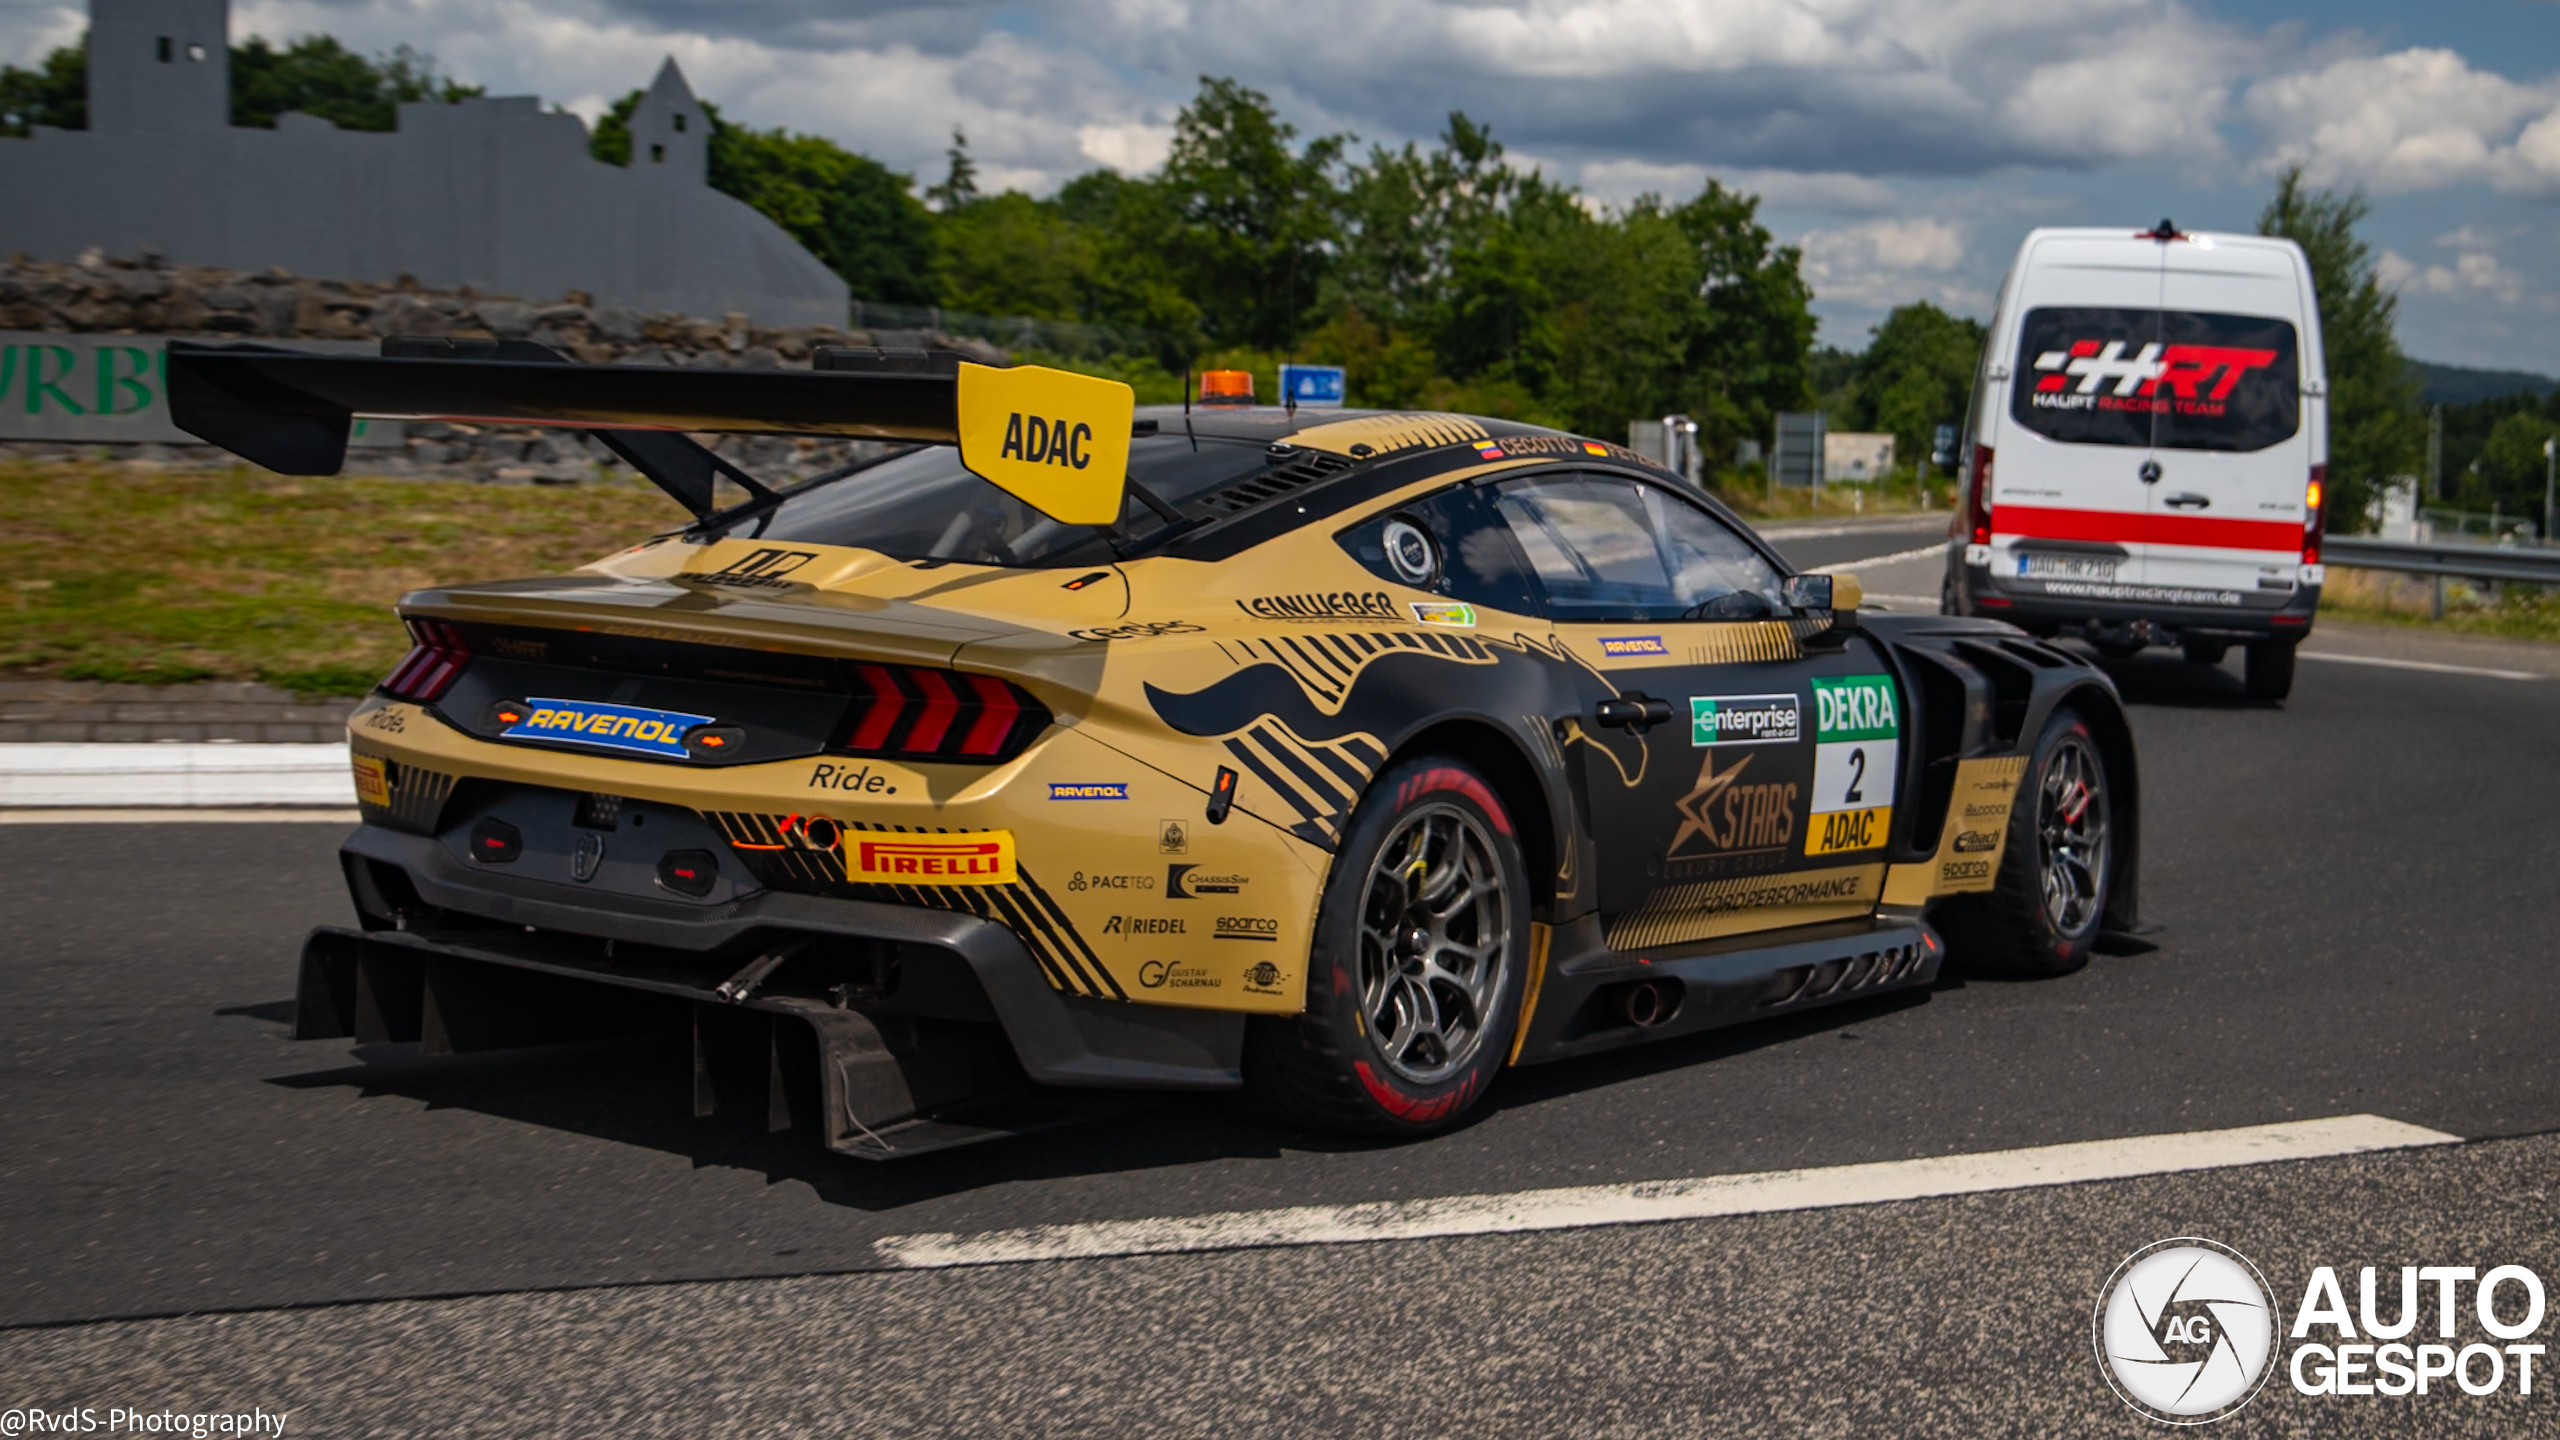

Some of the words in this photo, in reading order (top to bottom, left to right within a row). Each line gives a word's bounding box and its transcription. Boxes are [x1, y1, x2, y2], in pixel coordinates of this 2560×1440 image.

[2033, 394, 2096, 410] HAUPT
[2097, 399, 2168, 414] RACING
[1001, 412, 1092, 470] ADAC
[1499, 437, 1579, 455] CECOTTO
[1605, 640, 1662, 652] RAVENOL
[1693, 704, 1797, 735] enterprise
[1816, 685, 1896, 731] DEKRA
[526, 709, 679, 744] RAVENOL
[809, 764, 897, 795] Ride.
[1844, 747, 1866, 803] 2
[1054, 786, 1123, 797] RAVENOL
[1720, 782, 1797, 849] STARS
[1820, 810, 1874, 850] ADAC
[860, 842, 1000, 875] PIRELLI
[1943, 861, 1989, 876] sparco
[1092, 876, 1155, 889] PACETEQ
[1133, 919, 1186, 934] RIEDEL
[1216, 917, 1278, 932] sparco
